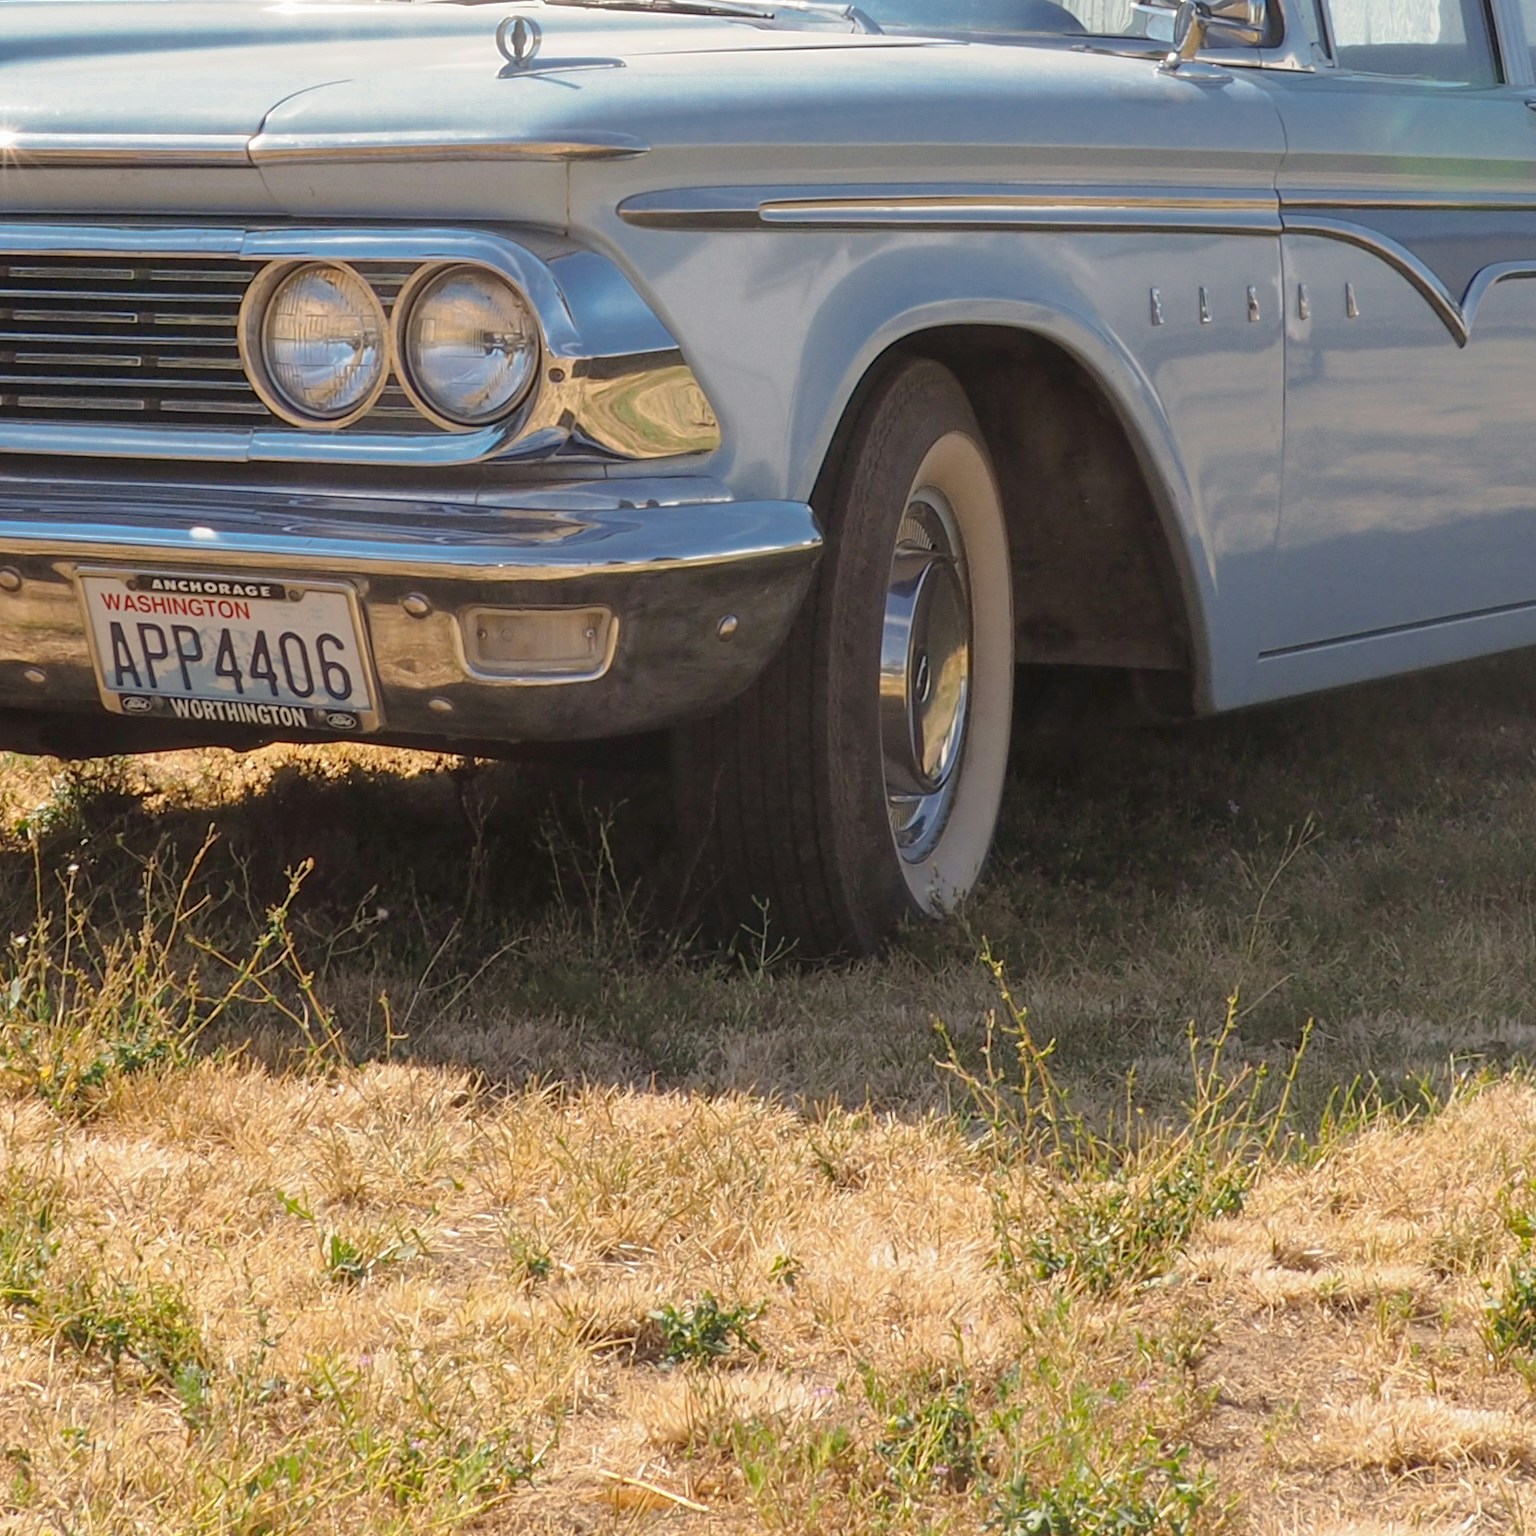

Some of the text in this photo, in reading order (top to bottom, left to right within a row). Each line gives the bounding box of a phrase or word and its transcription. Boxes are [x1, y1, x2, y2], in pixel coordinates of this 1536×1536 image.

[151, 578, 272, 598] ANCHORAGE
[101, 592, 251, 620] WASHINGTON
[109, 621, 353, 701] APP4406
[170, 697, 308, 728] WORTHINGTON
